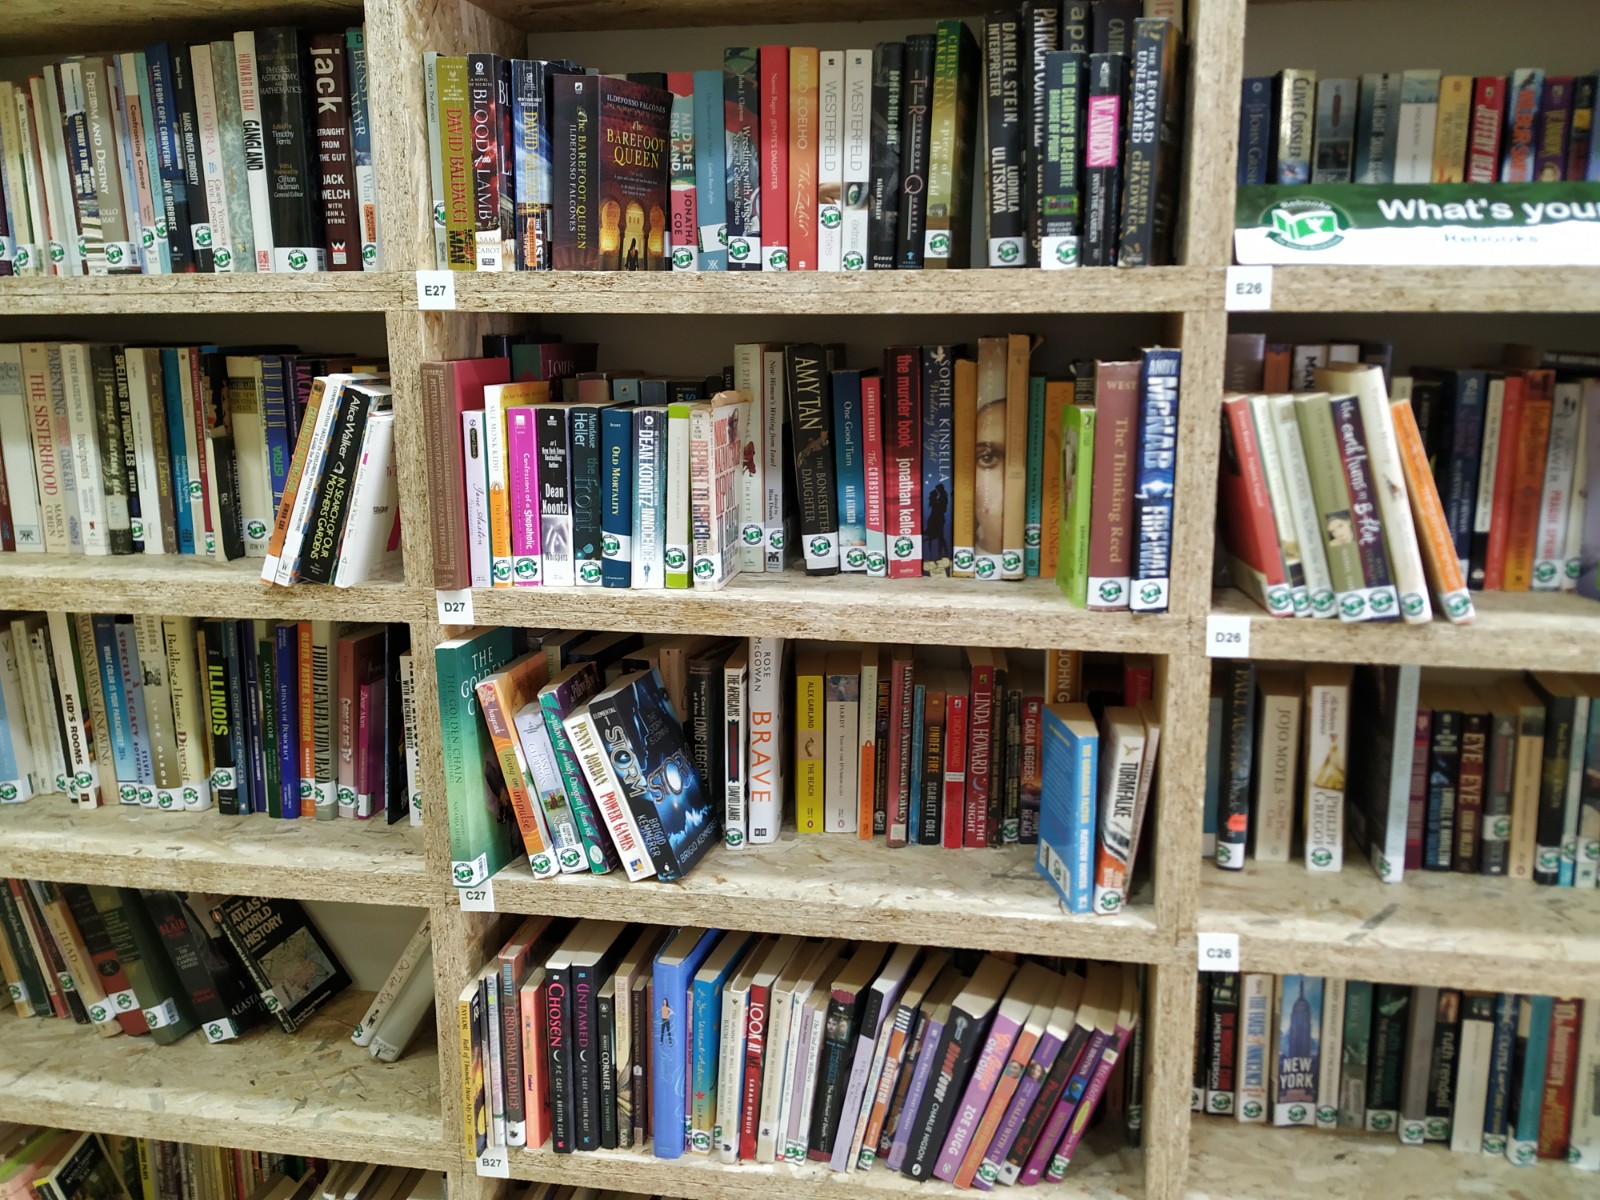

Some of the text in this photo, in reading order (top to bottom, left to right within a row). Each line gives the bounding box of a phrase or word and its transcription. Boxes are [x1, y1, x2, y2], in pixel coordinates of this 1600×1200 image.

[310, 48, 343, 114] jack
[989, 24, 1000, 96] INTERPRETER
[238, 53, 264, 170] HOWARD BLUM GANGLAND
[1132, 50, 1147, 143] UNLEASHED
[1289, 78, 1310, 157] CLIVE CUSSLER
[84, 72, 109, 195] FREEDOM AND DESTINY
[129, 105, 146, 190] Confronting Cancer
[182, 112, 199, 186] MARS ROVER CURIOSITY
[317, 128, 345, 136] STRAIGHT
[446, 110, 464, 150] DAVID
[607, 129, 665, 152] BAREFOOT
[671, 112, 681, 171] ENGLAND
[682, 113, 693, 171] MIDDLE
[825, 81, 837, 171] WESTERFELD
[851, 80, 864, 171] WESTERFELD
[576, 106, 587, 250] The BAREFOOT QUEEN
[614, 147, 660, 169] QUEEN
[992, 147, 1006, 214] ULITSKAYA
[163, 179, 177, 231] JAY BARBREE
[322, 175, 350, 200] JACK WELCH
[450, 153, 468, 224] BALDACCI
[1008, 166, 1018, 213] LUDMILA
[1126, 151, 1142, 234] CHADWICK
[1377, 198, 1514, 221] What's
[674, 213, 682, 235] COE
[425, 286, 446, 296] E27
[1235, 283, 1262, 294] E26
[1107, 381, 1136, 389] WEST
[1149, 360, 1178, 374] ANDY
[795, 357, 822, 430] AMY TAN
[897, 355, 913, 447] the murder book
[30, 372, 57, 496] THE SISTERHOOD
[339, 396, 360, 458] Alice Walker
[575, 412, 588, 447] Heller
[844, 401, 853, 466] One Good Turn
[938, 360, 950, 481] SOPHIE KINSELLA
[545, 484, 563, 498] Dean
[611, 446, 621, 516] OLD MORTALITY
[639, 430, 655, 561] DEAN KOONTZ INNOCENCE
[691, 440, 711, 540] REPORT TO GRECO
[802, 469, 815, 523] DAUGHTER
[816, 472, 830, 532] BONESETTER
[897, 458, 913, 506] jonathan
[1110, 418, 1128, 562] The Thinking Reed
[55, 504, 64, 538] MARCIA
[321, 478, 346, 558] IN SEARCH OF OUR
[542, 500, 568, 515] Koontz
[545, 552, 568, 562] Whispers
[444, 603, 465, 612] D27
[472, 646, 493, 671] THE
[1216, 632, 1241, 643] D26
[119, 631, 139, 737] SPECIAL LEGACY
[208, 665, 228, 736] ILLINOIS
[727, 675, 740, 716] THE AFRICANS
[65, 694, 83, 764] KID'S ROOMS
[593, 707, 616, 719] ELEMENTAL
[971, 692, 990, 775] LINDA HOWARD
[605, 726, 646, 798] STORM
[752, 712, 772, 802] BRAVE
[928, 726, 940, 773] UNDER FIRE
[1023, 718, 1035, 781] CARLA NEGGERS
[1274, 710, 1291, 799] JOJO MOYES
[1463, 733, 1484, 763] EYE
[571, 722, 636, 851] PENNY JORDAN POWER GAMES
[1114, 763, 1138, 818] TURMFALKE
[1459, 775, 1482, 804] EYE
[637, 815, 660, 856] KEMMERER
[650, 819, 666, 846] BRIGID
[967, 802, 975, 833] NIGHT
[680, 840, 698, 864] BRIGID
[231, 897, 261, 924] ATLAS
[236, 906, 271, 935] WORLD
[465, 891, 486, 900] C27
[160, 919, 186, 935] BLAIR
[243, 913, 283, 948] HISTORY
[1207, 948, 1232, 959] C26
[548, 983, 565, 1047] CHOSEN
[576, 983, 589, 1047] UNTAMED
[747, 1003, 764, 1053] LOOK AT
[602, 1052, 610, 1090] CORMIER
[973, 1039, 996, 1080] ON TOUR
[1212, 1013, 1222, 1089] JAMES PATTERSON
[1283, 1058, 1312, 1073] NEW
[877, 1057, 896, 1104] SASQUATCH
[1280, 1074, 1313, 1089] YORK
[916, 1103, 939, 1161] CHARLIE HIGSON
[949, 1105, 976, 1155] ZOE SUGG
[483, 1158, 501, 1167] B27
